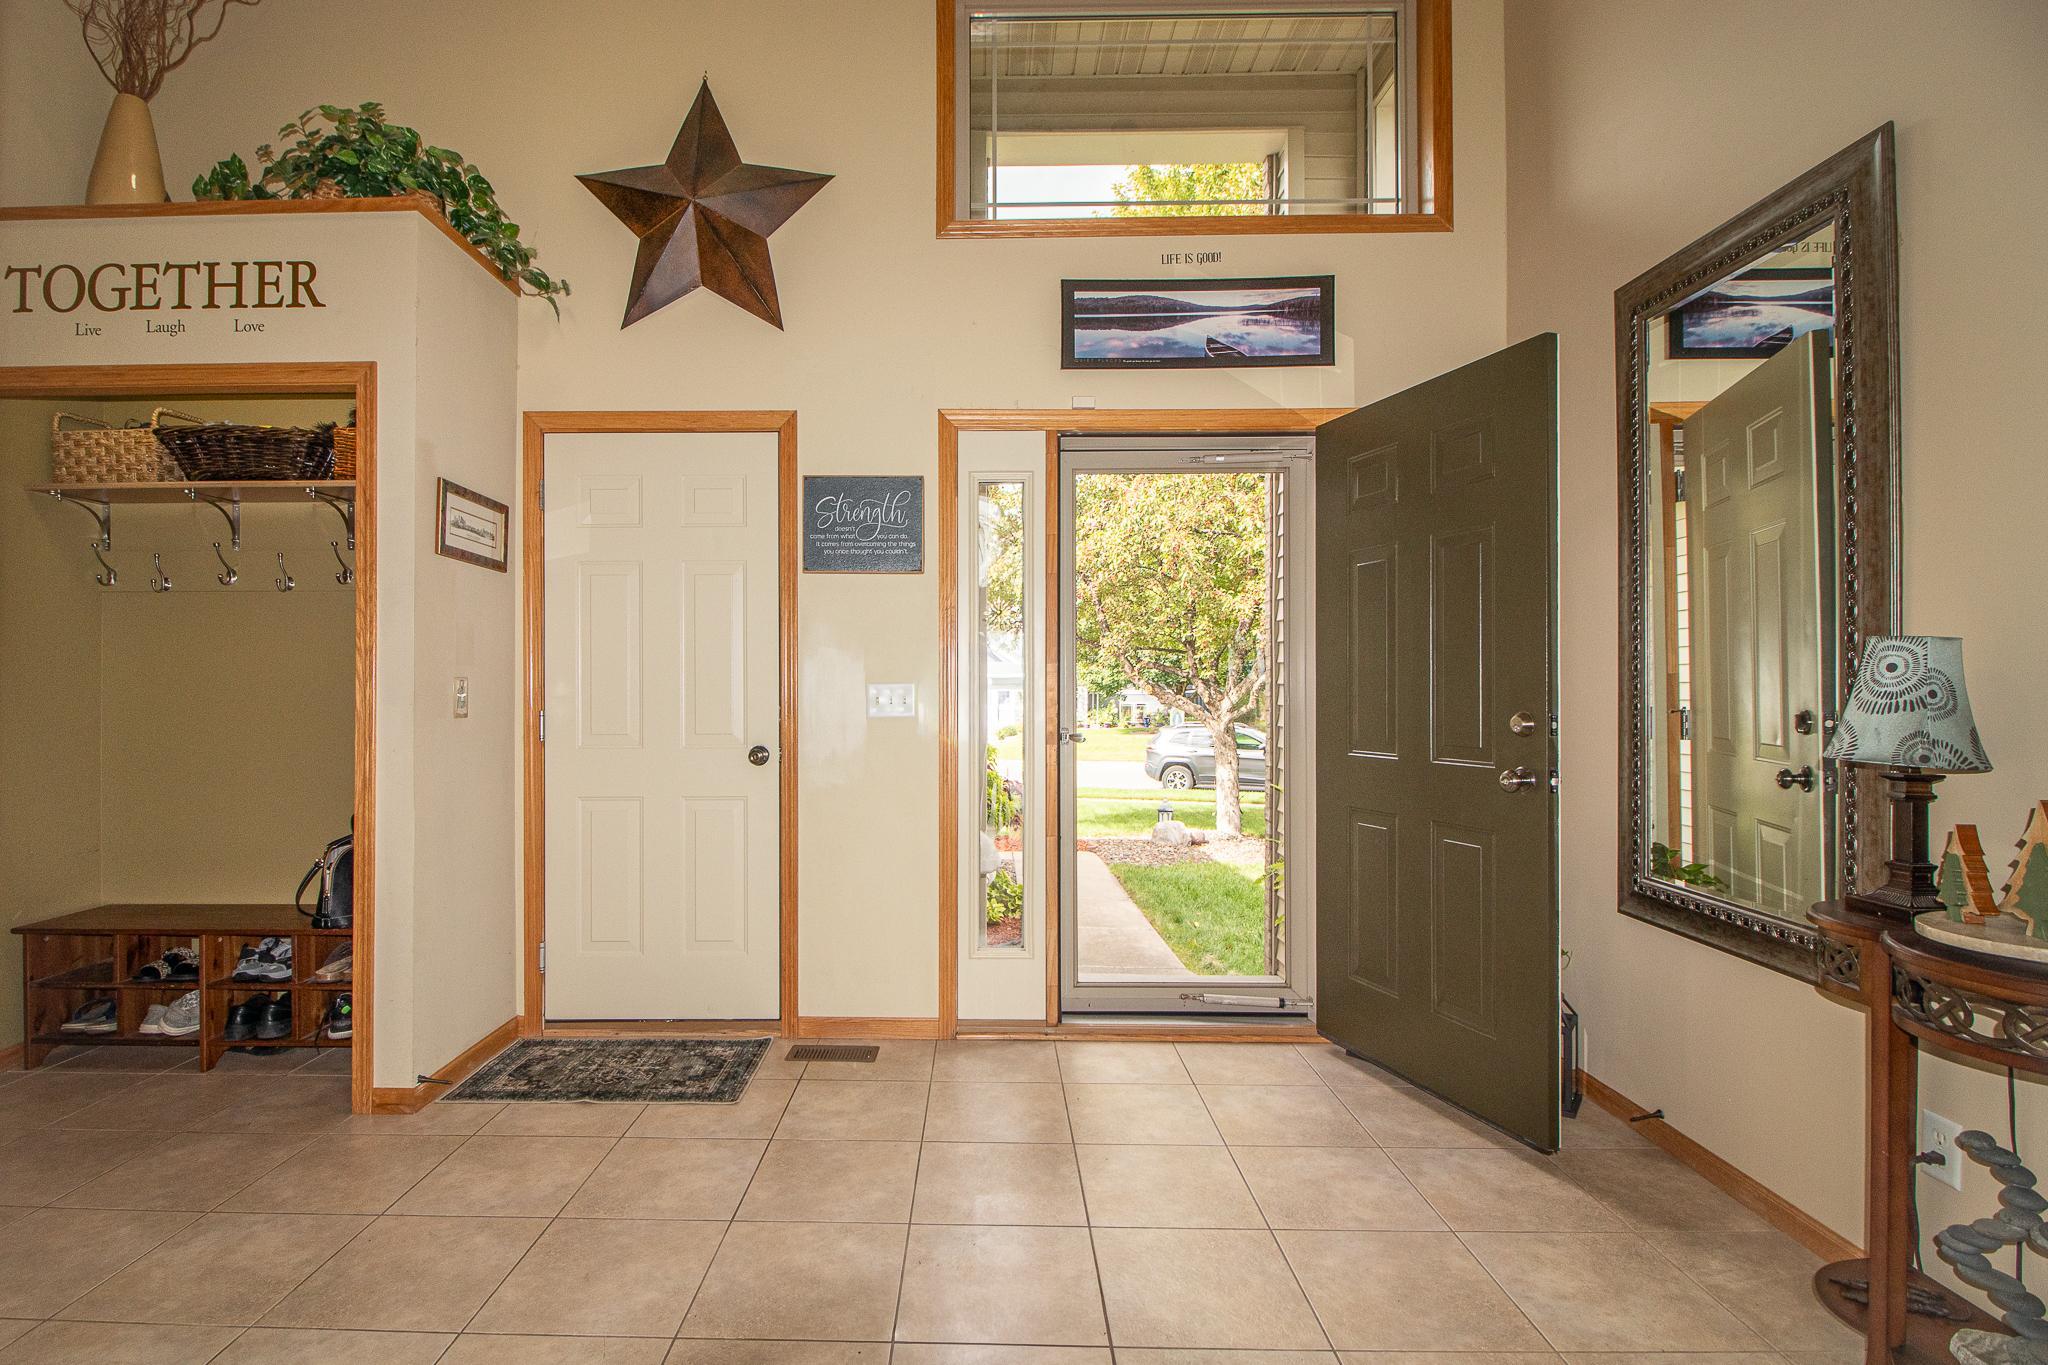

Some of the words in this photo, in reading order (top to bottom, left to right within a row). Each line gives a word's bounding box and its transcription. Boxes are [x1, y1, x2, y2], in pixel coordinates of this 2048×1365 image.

[1161, 253, 1182, 265] LIFE
[1184, 252, 1194, 264] IS
[1196, 251, 1222, 266] GOOD!
[4, 261, 327, 313] TOGETHER
[75, 322, 102, 336] Live
[146, 319, 186, 337] Laugh
[234, 318, 265, 333] Love
[815, 490, 912, 541] Strength
